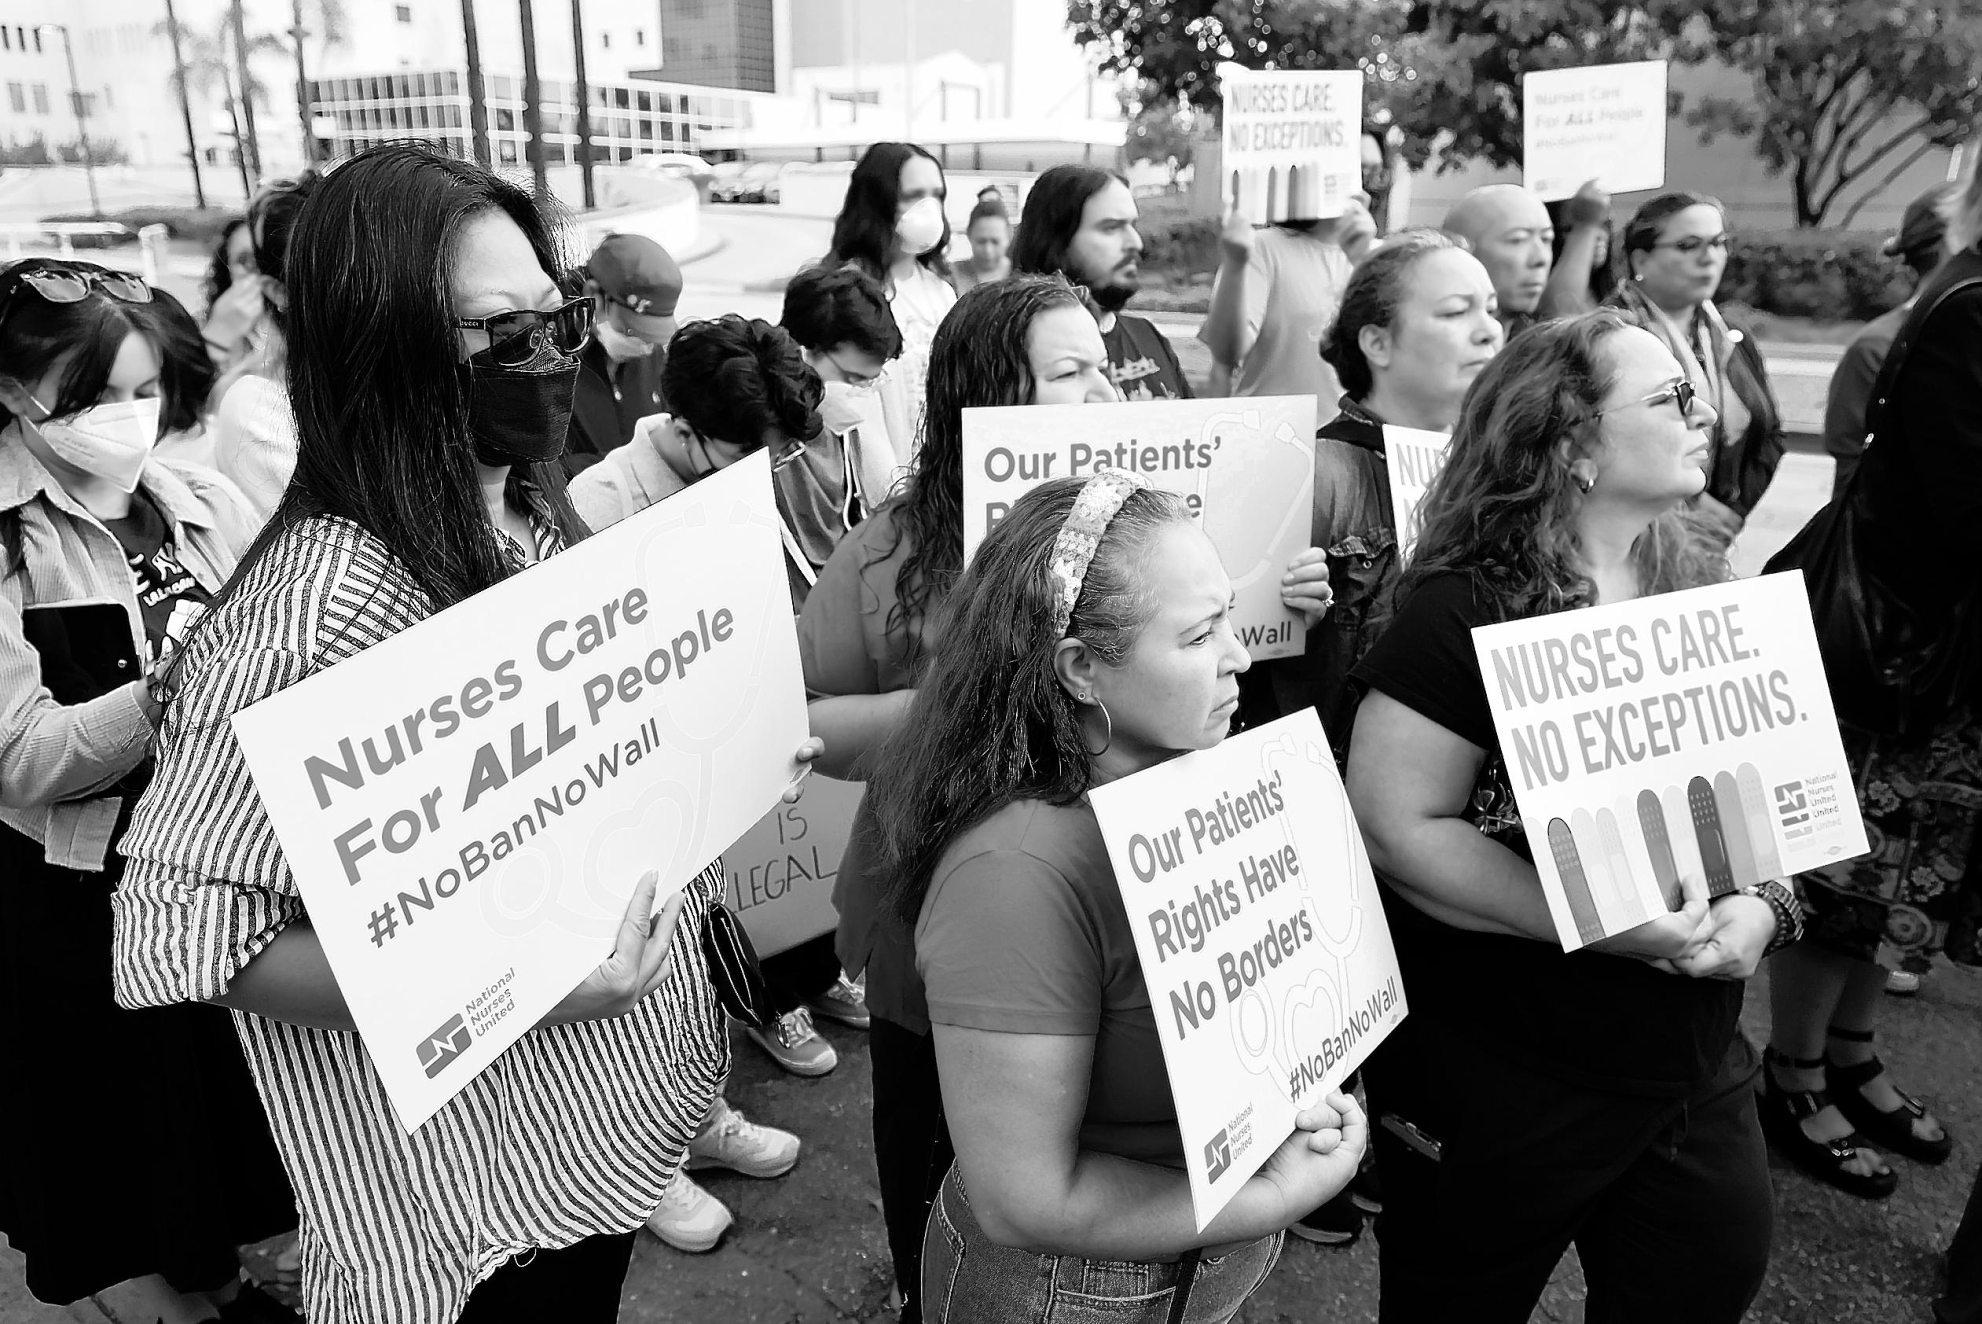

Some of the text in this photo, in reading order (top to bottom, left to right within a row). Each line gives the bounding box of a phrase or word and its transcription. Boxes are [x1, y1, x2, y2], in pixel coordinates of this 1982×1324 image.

[1229, 123, 1249, 151] NO
[984, 436, 1221, 483] Our Patients’
[1491, 604, 1760, 711] NURSES CARE.
[303, 587, 648, 810] Nurses Care
[1511, 669, 1808, 790] NO EXCEPTIONS.
[333, 607, 735, 886] For ALL People
[367, 717, 660, 948] #NoBanNoWall
[777, 807, 808, 845] IS
[1128, 769, 1284, 883] Our Patients’
[733, 845, 839, 914] LEGAL
[1148, 844, 1300, 963] Rights Have
[465, 967, 515, 1014] National
[470, 988, 512, 1026] Nurses
[1169, 909, 1313, 1041] No Borders
[475, 999, 515, 1037] United
[1289, 975, 1398, 1104] #NoBanNoWall
[1228, 1100, 1253, 1132] National
[1230, 1121, 1251, 1147] Nurses
[1232, 1132, 1253, 1160] United
